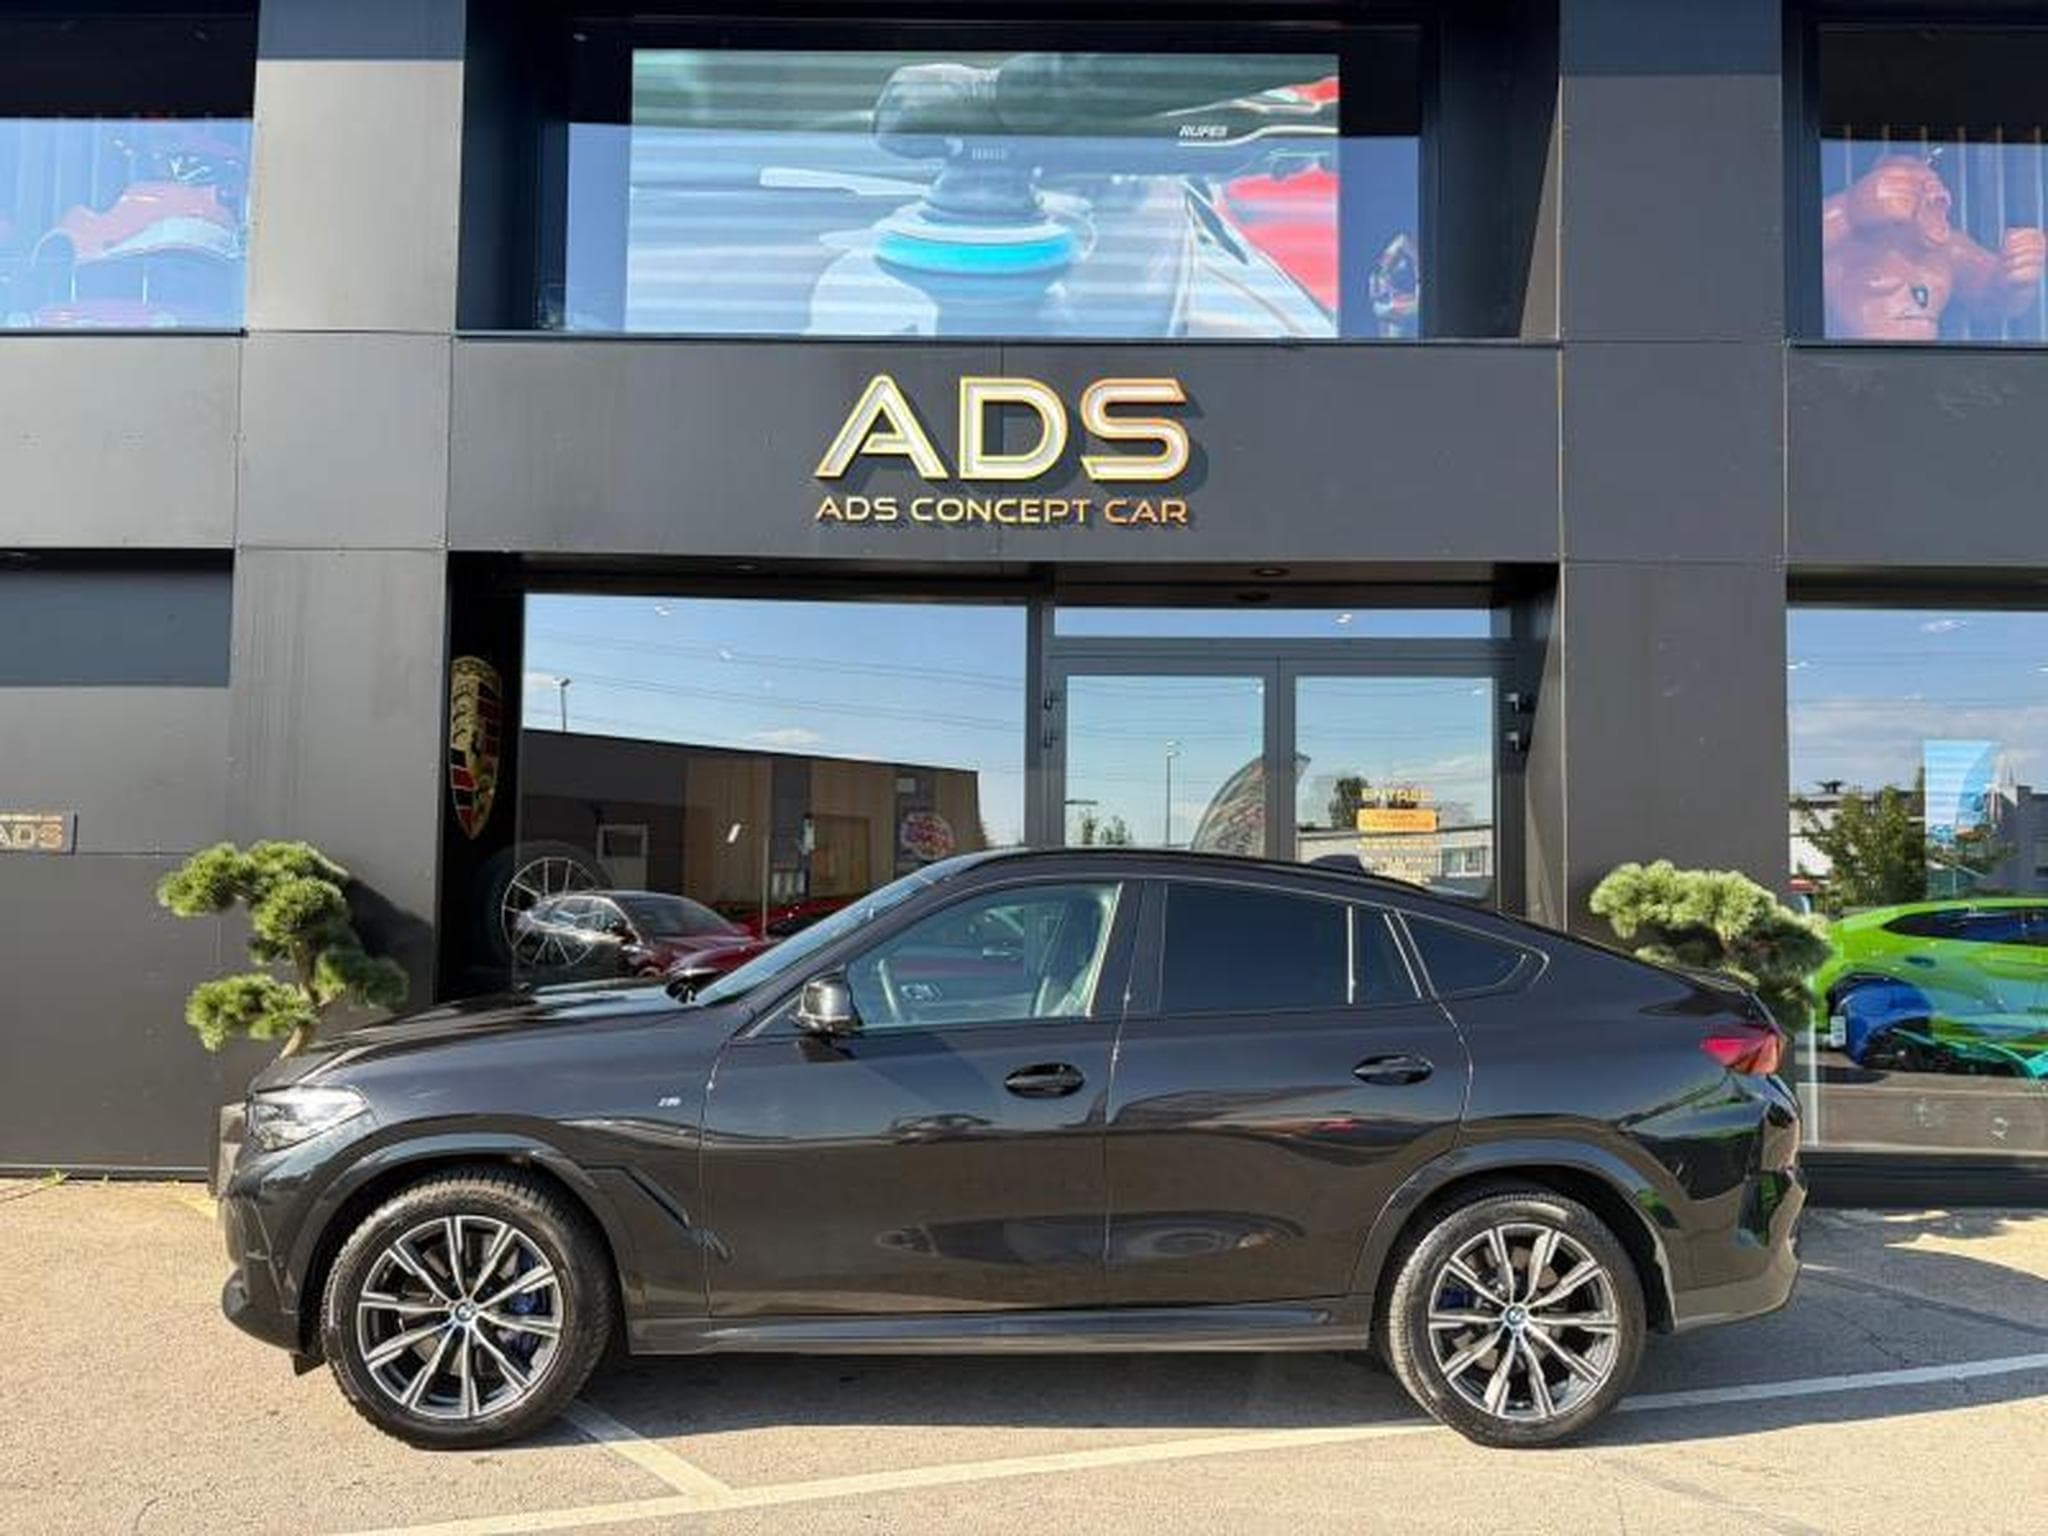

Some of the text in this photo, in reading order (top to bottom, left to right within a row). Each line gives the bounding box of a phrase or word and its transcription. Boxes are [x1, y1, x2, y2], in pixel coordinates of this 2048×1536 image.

[815, 374, 1190, 480] ADS
[815, 496, 1188, 524] ADS CONCEPT CAR
